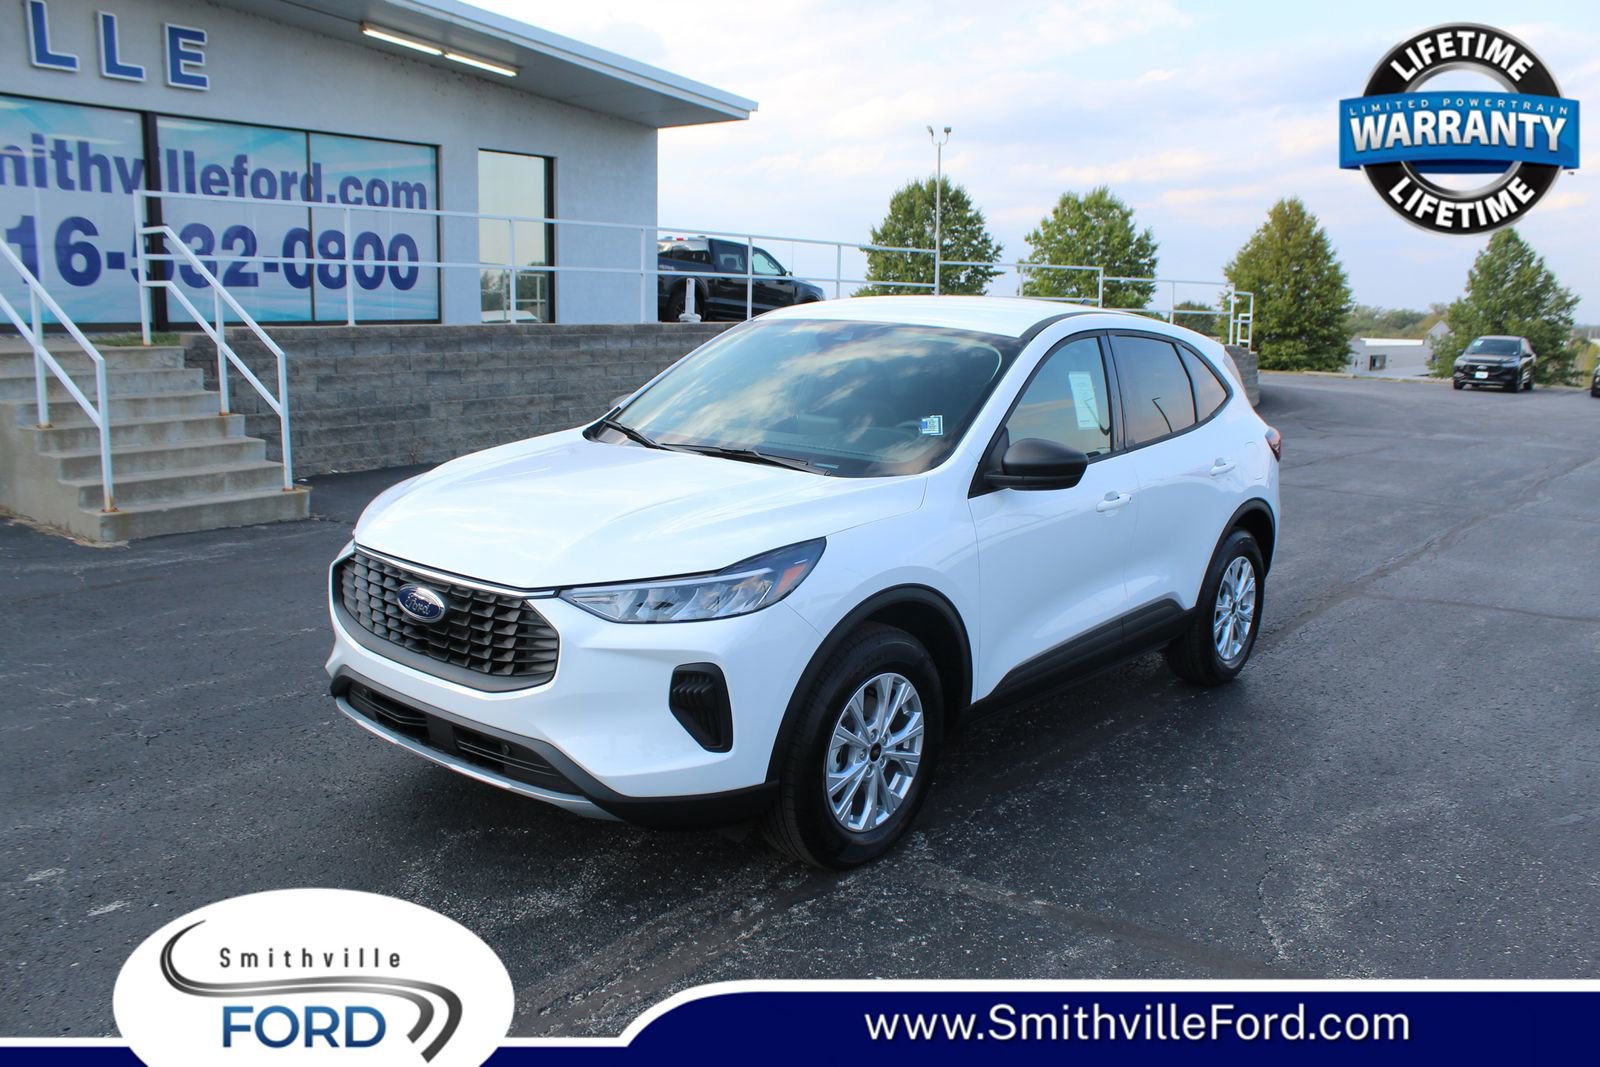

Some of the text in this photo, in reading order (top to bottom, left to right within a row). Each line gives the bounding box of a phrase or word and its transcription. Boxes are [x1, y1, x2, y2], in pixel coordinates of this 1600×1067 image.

[26, 0, 209, 91] LLE
[0, 132, 428, 210] ithvlleford.com
[405, 592, 431, 615] Ford
